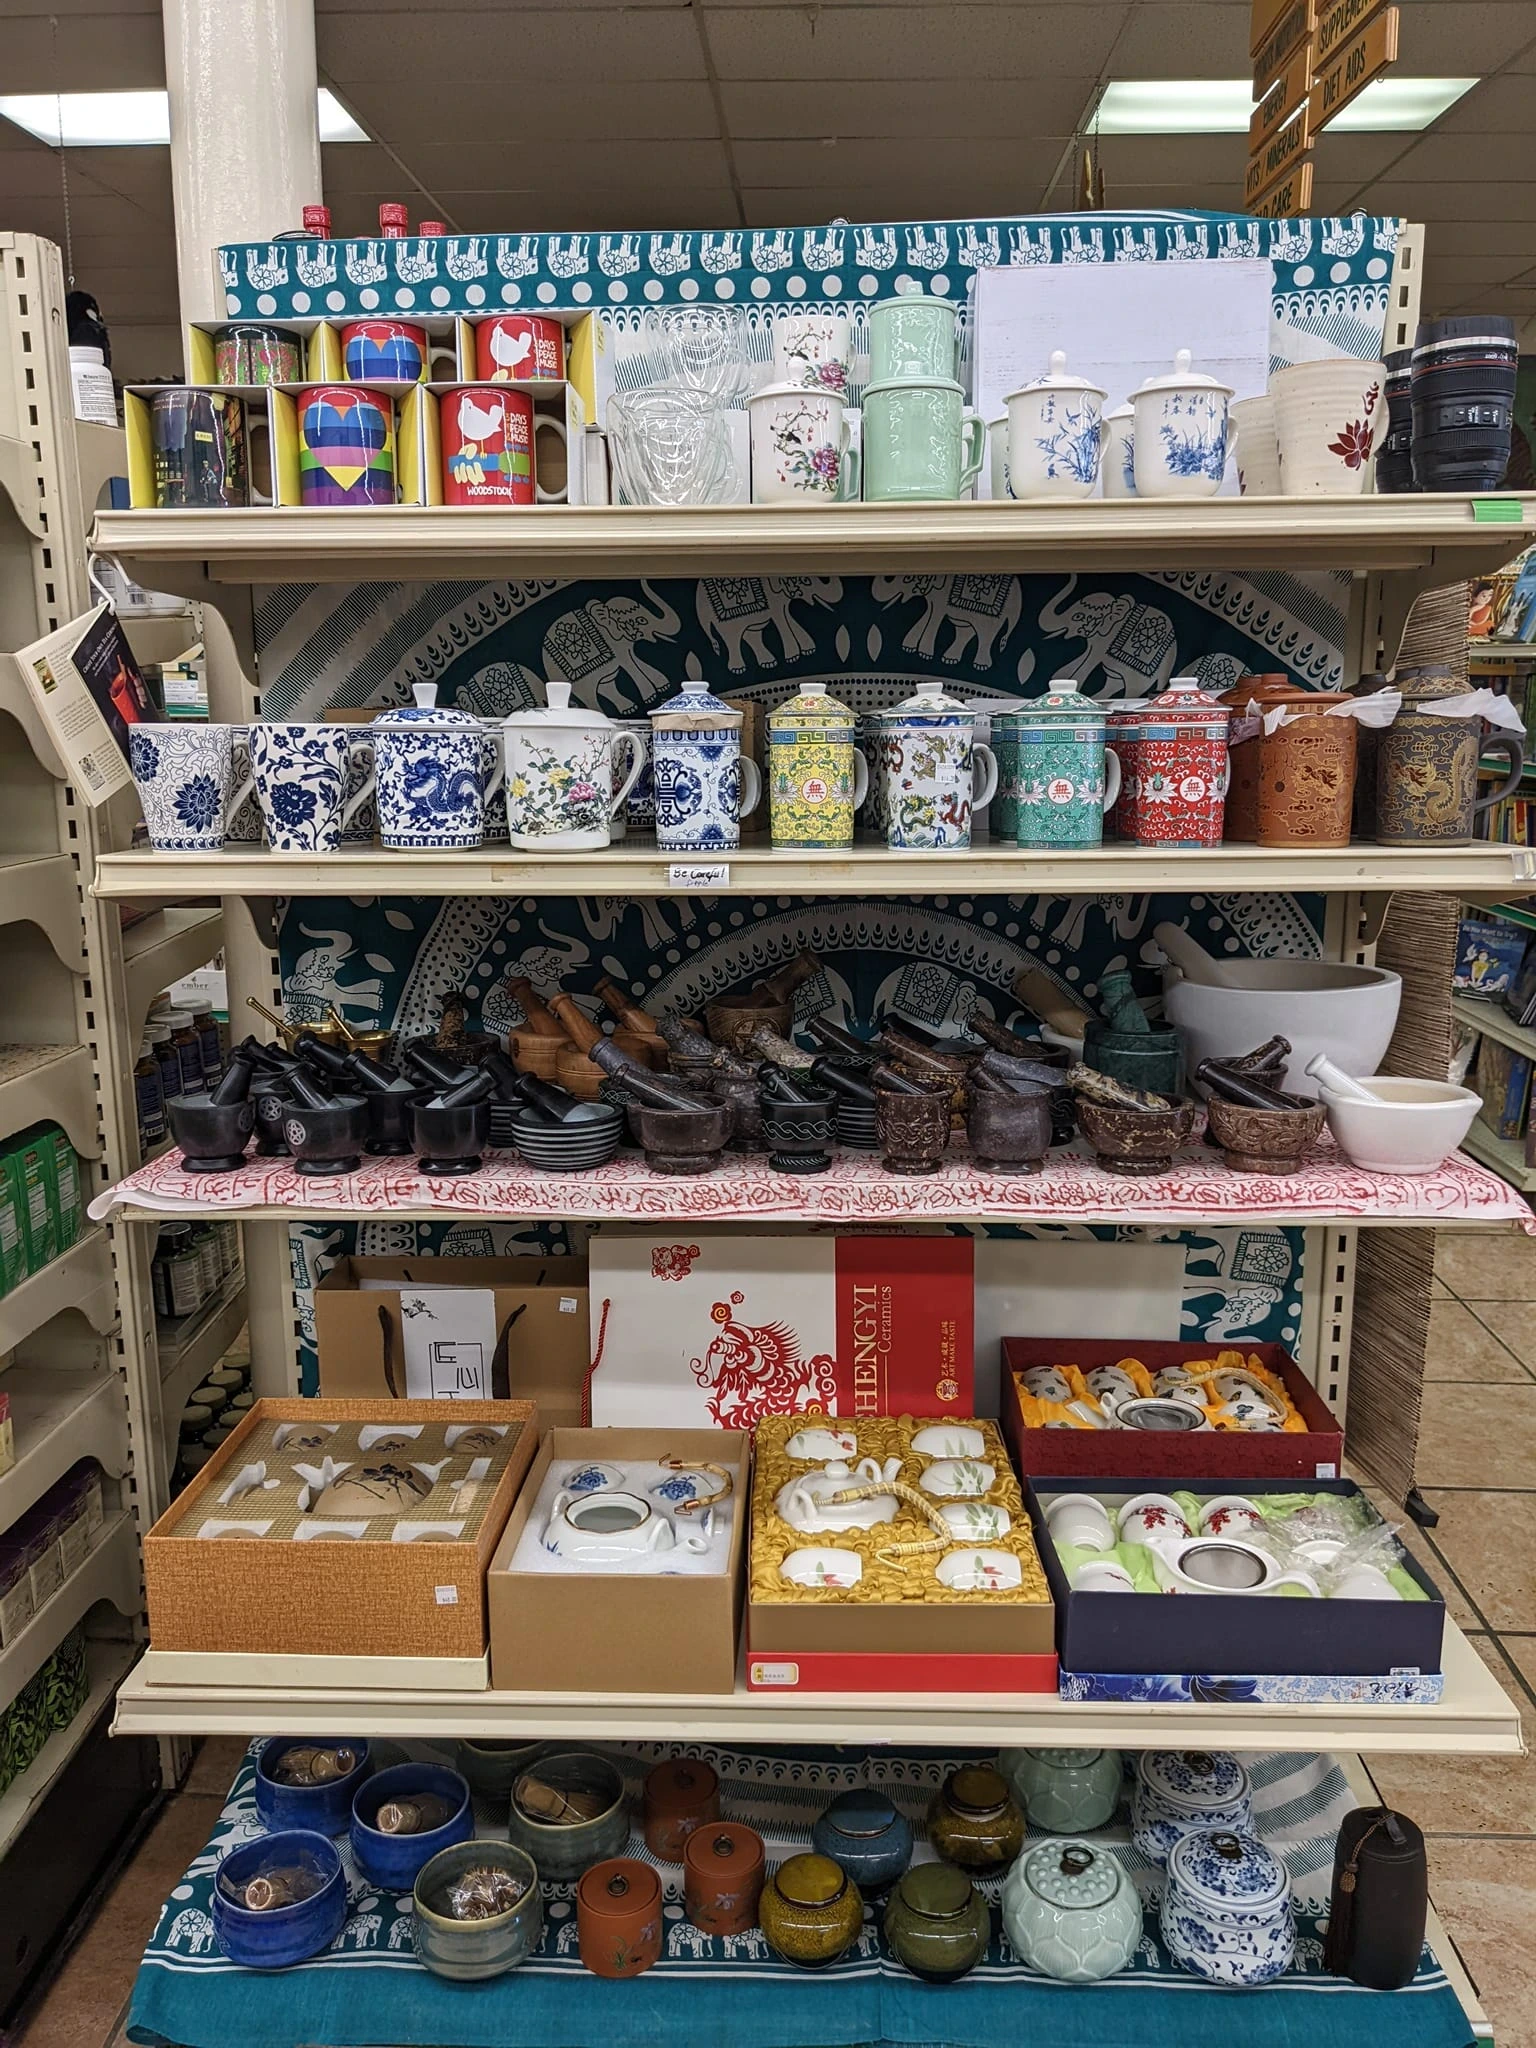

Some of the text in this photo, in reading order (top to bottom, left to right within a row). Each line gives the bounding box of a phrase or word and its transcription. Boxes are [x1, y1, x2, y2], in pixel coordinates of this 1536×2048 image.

[1324, 66, 1342, 110] DIET
[1345, 41, 1366, 91] AIDS
[1266, 118, 1300, 176] MINERALS
[538, 339, 556, 350] DAYS
[538, 350, 557, 360] PEACE
[539, 359, 557, 369] MUSIC
[510, 412, 527, 425] DAYS
[510, 423, 528, 435] PEACE
[510, 431, 528, 444] MUSIC
[466, 485, 512, 496] WOODSTOCK
[181, 982, 209, 990] ember
[877, 1285, 892, 1353] Ceramics
[853, 1284, 878, 1419] HENGYI
[949, 1320, 957, 1378] ART MAKE TASTE
